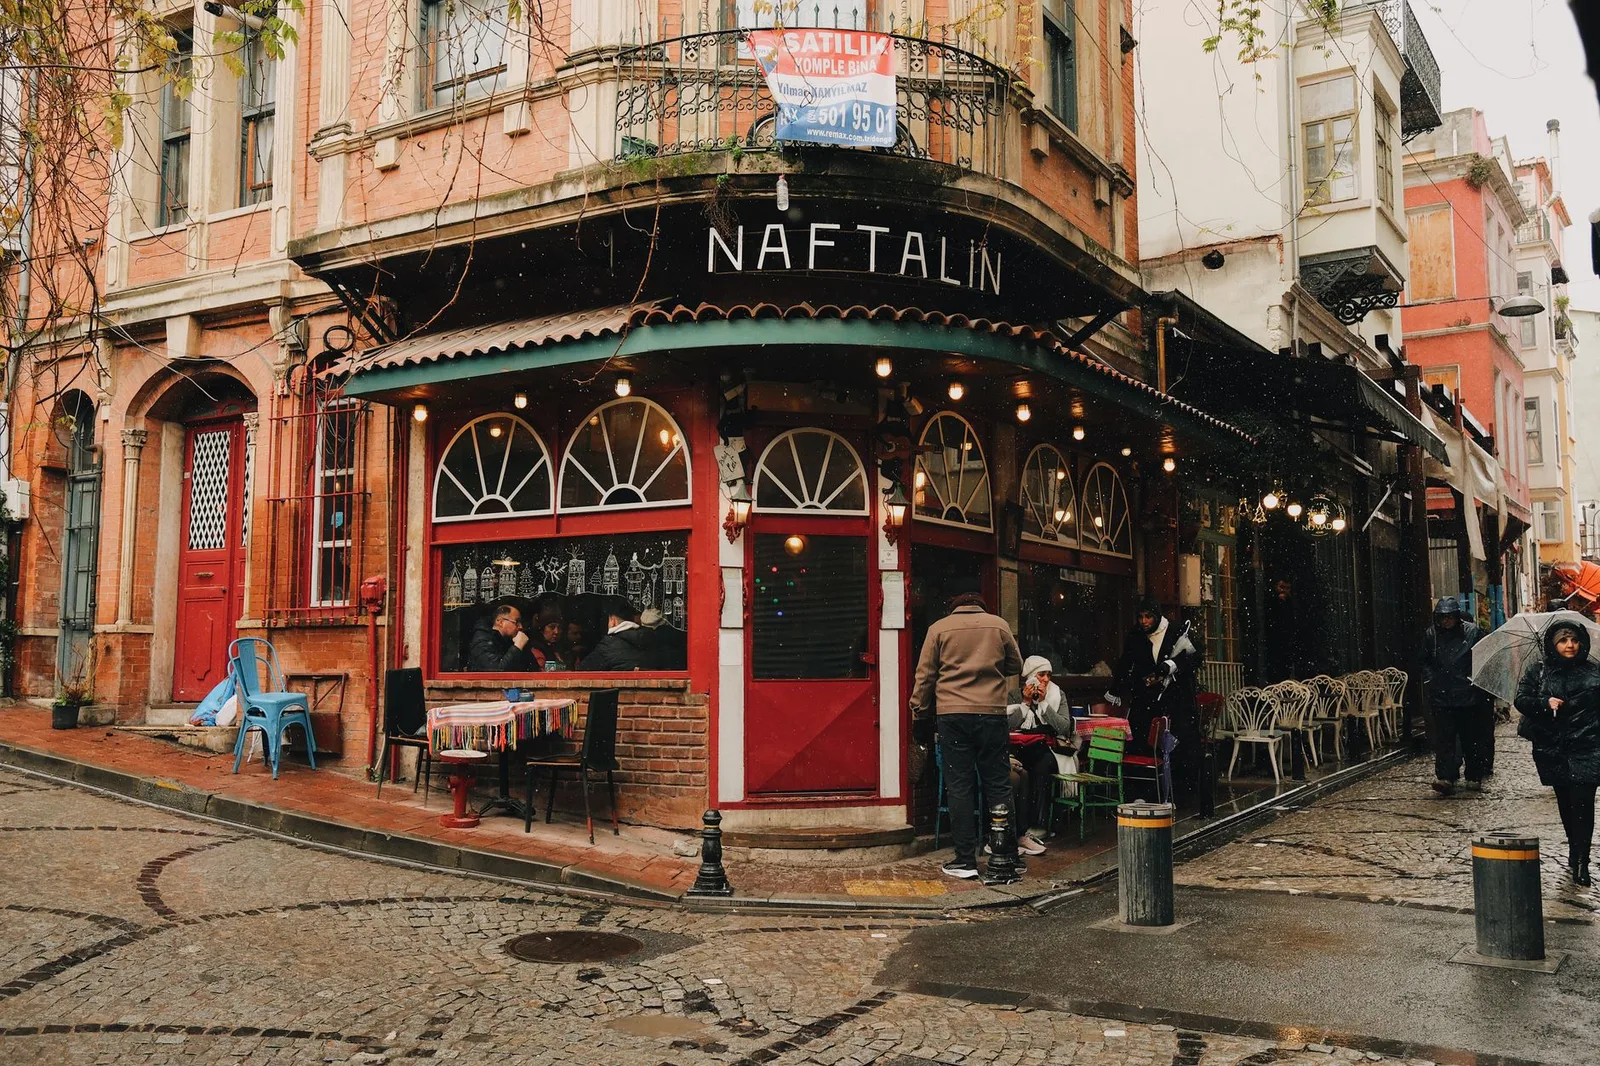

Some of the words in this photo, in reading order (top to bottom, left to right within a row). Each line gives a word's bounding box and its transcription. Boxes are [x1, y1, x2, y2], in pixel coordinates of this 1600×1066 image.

[782, 32, 888, 56] SATILIK
[795, 57, 844, 75] KOMPLE
[819, 104, 846, 128] 501
[852, 102, 871, 132] 95
[875, 107, 893, 133] 01
